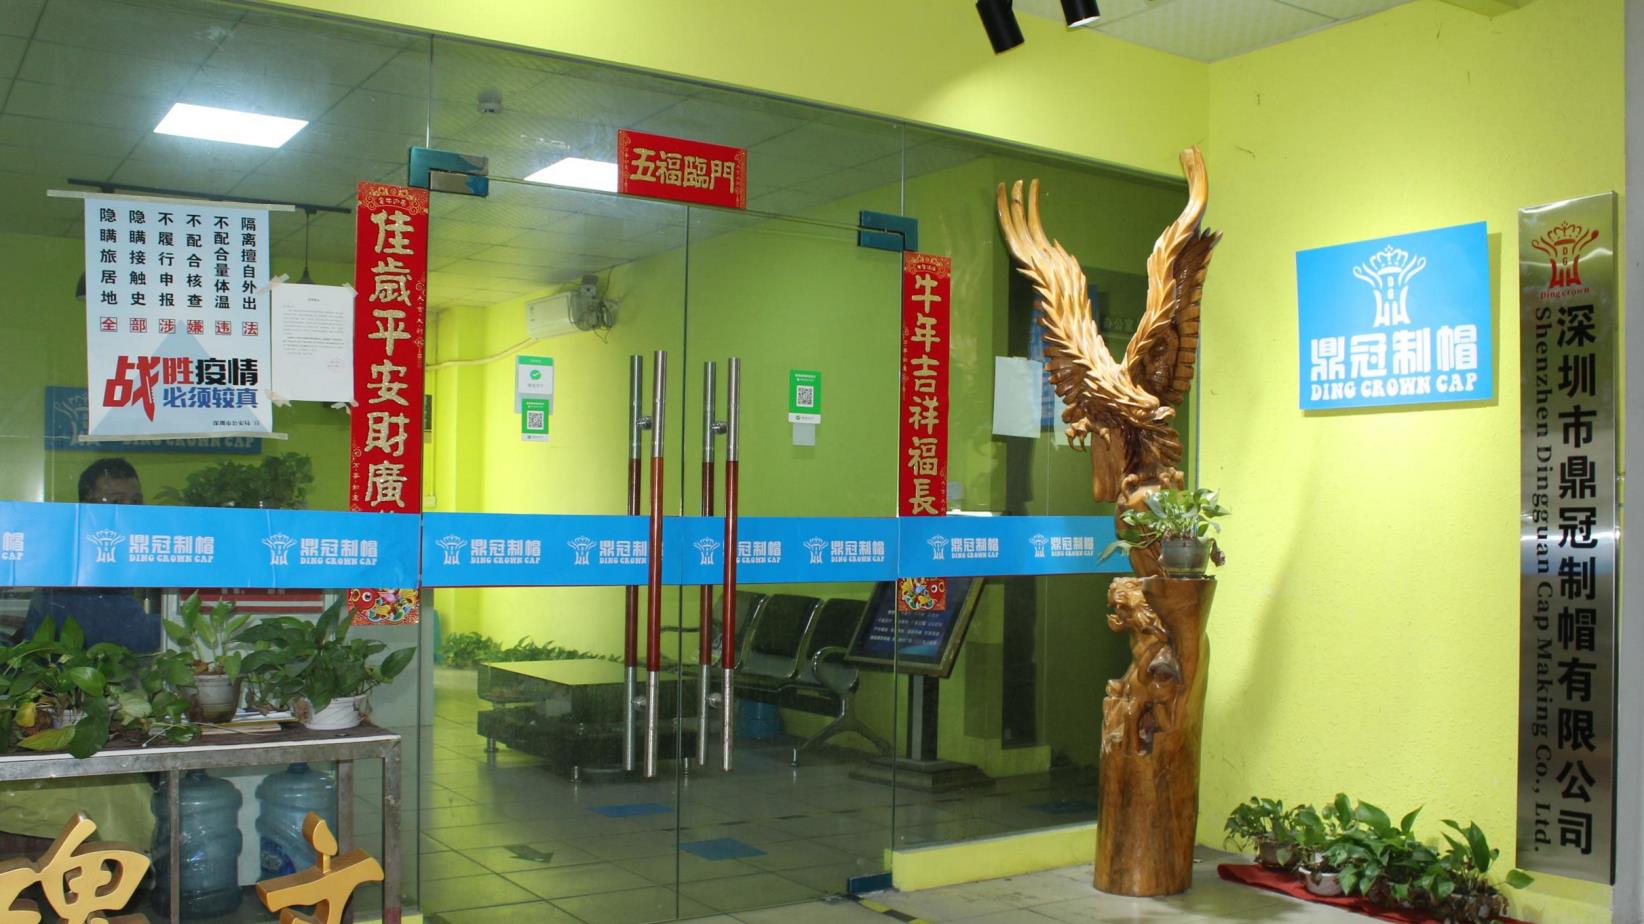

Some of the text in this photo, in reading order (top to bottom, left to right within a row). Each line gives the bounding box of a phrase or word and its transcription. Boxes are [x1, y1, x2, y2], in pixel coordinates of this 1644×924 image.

[630, 147, 735, 194] 五福臨門
[100, 208, 118, 306] 隐瞒旅居地
[129, 210, 147, 306] 隐瞒接触史
[158, 212, 175, 307] 不履行申报
[186, 214, 202, 308] 不配合核查
[214, 216, 230, 309] 不配合量体温
[241, 217, 257, 310] 隔离擅自外出
[100, 317, 258, 337] 全部涉嫌违法
[1311, 324, 1478, 382] 鼎冠制帽
[102, 355, 259, 422] 战胜疫情
[163, 386, 259, 409] 必须较真
[1311, 372, 1478, 400] DING CROWN CAP
[129, 534, 214, 554] 鼎冠制帽
[129, 554, 213, 563] DING CROWN CAP
[301, 538, 378, 557] 鼎冠制帽
[301, 557, 377, 566] DING CROWN CAP
[471, 538, 541, 557] 鼎冠制帽
[471, 556, 541, 564] DING CROWN CAP
[600, 540, 647, 557] 鼎冠制
[736, 541, 781, 556] 冠制帽
[1531, 307, 1553, 852] Shenzhen Dingguan Cap Making Co., Ltd.
[1556, 303, 1598, 855] 深圳市鼎冠制帽有限公司
